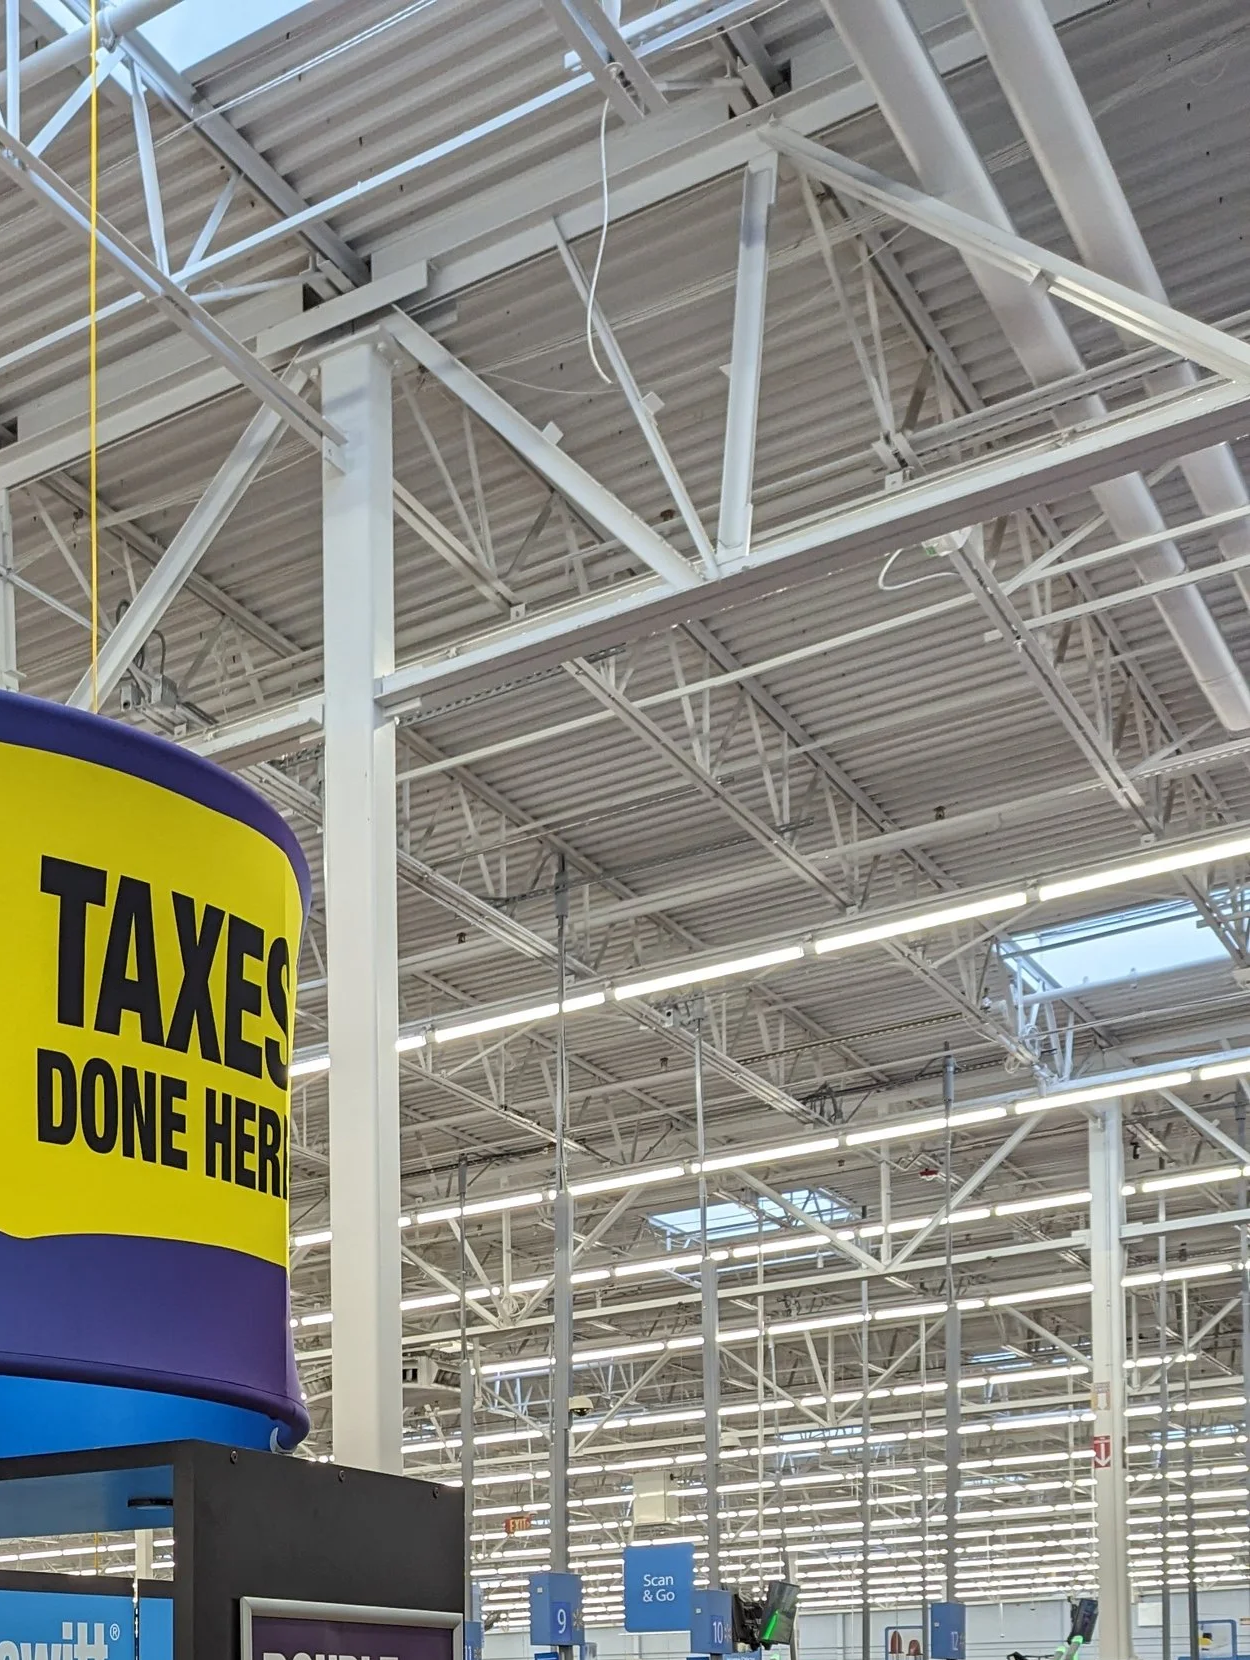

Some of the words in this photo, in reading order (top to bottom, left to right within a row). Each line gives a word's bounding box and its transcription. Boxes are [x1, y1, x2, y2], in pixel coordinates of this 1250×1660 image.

[40, 855, 290, 1091] TAXES
[37, 1048, 187, 1171] DONE
[205, 1087, 288, 1200] HER
[509, 1518, 526, 1532] EXIT
[643, 1574, 674, 1587] Scan
[642, 1590, 653, 1602] &
[656, 1589, 675, 1602] Go
[558, 1608, 567, 1634] 9
[712, 1621, 724, 1644] 10
